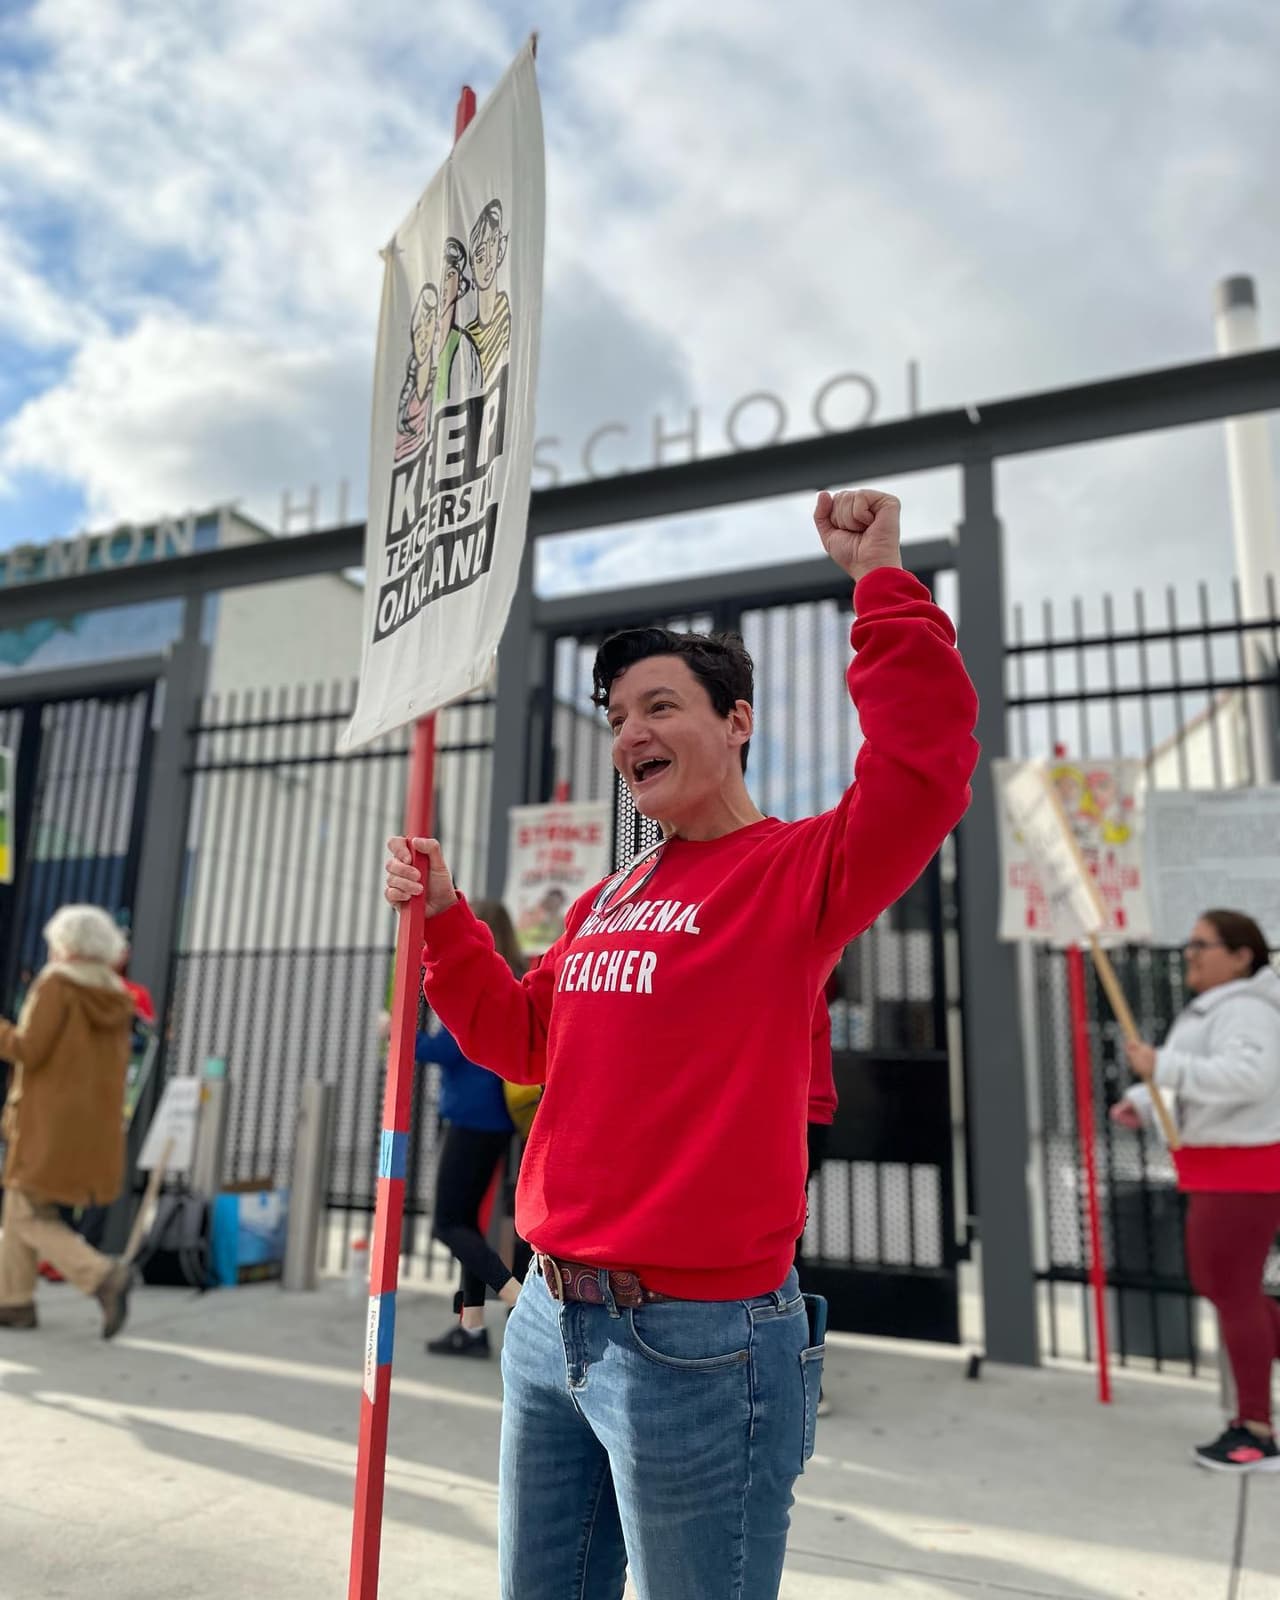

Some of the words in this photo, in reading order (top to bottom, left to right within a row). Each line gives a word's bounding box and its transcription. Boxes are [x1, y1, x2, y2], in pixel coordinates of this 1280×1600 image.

[391, 387, 500, 535] KEEP
[533, 359, 922, 489] SCHOOL
[378, 523, 486, 633] OAKLAND
[387, 487, 472, 577] TEACERS
[575, 900, 703, 940] HENOMENAL
[558, 950, 657, 994] TEACHER
